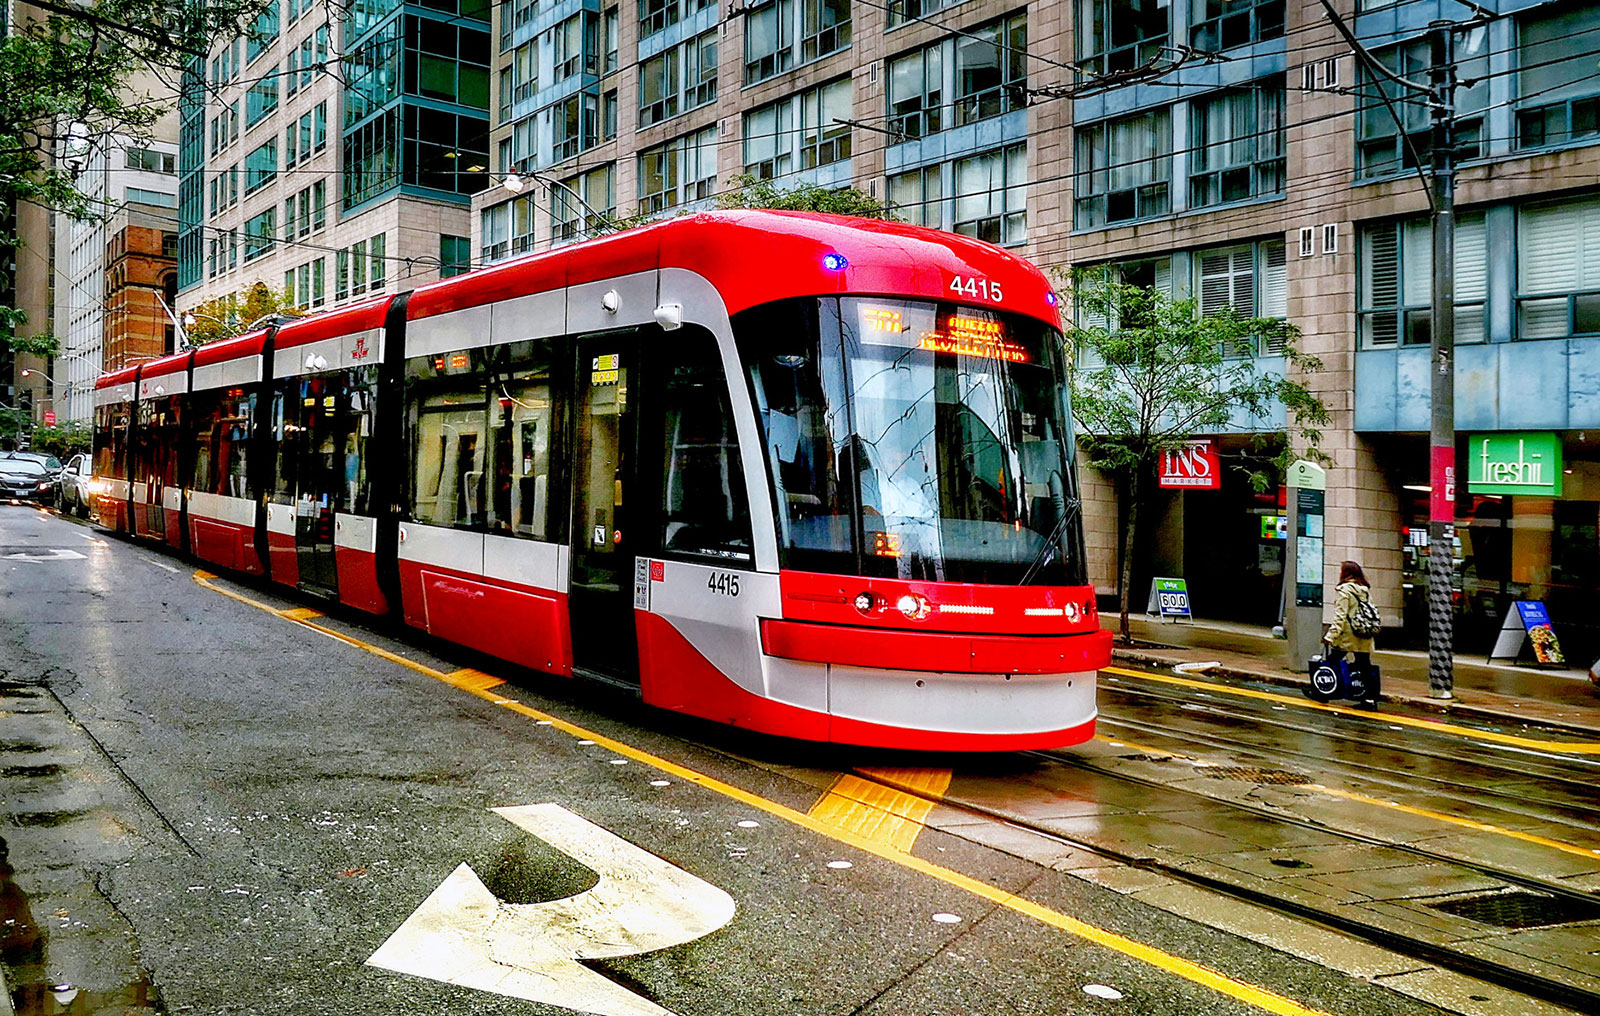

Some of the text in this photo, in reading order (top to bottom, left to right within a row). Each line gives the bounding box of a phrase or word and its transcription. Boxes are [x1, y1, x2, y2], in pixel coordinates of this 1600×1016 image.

[950, 275, 1003, 302] 4415
[1480, 439, 1542, 483] freshii
[708, 571, 739, 597] 4415
